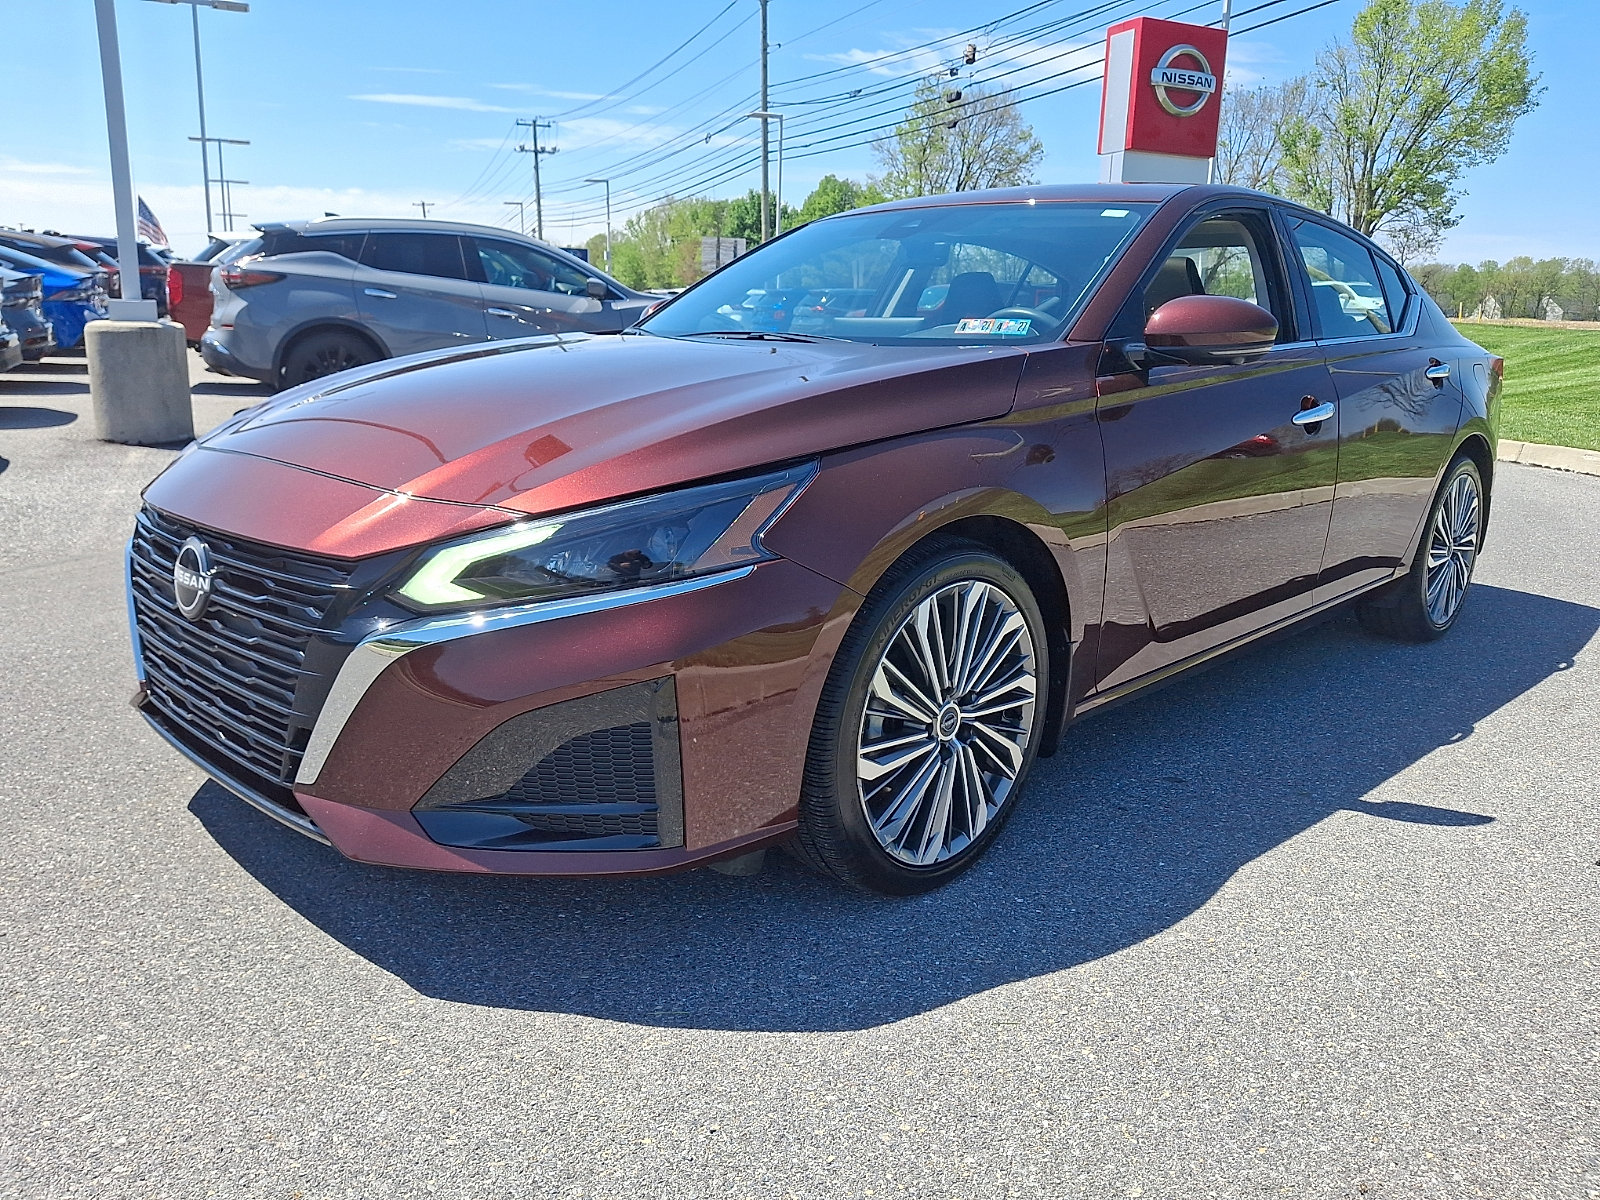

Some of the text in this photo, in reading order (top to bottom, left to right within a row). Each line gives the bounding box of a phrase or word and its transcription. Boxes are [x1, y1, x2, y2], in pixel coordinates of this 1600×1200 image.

[1161, 71, 1213, 89] NISSAN
[960, 322, 967, 331] 4
[996, 321, 1027, 332] 4 27
[175, 566, 209, 590] SSAN
